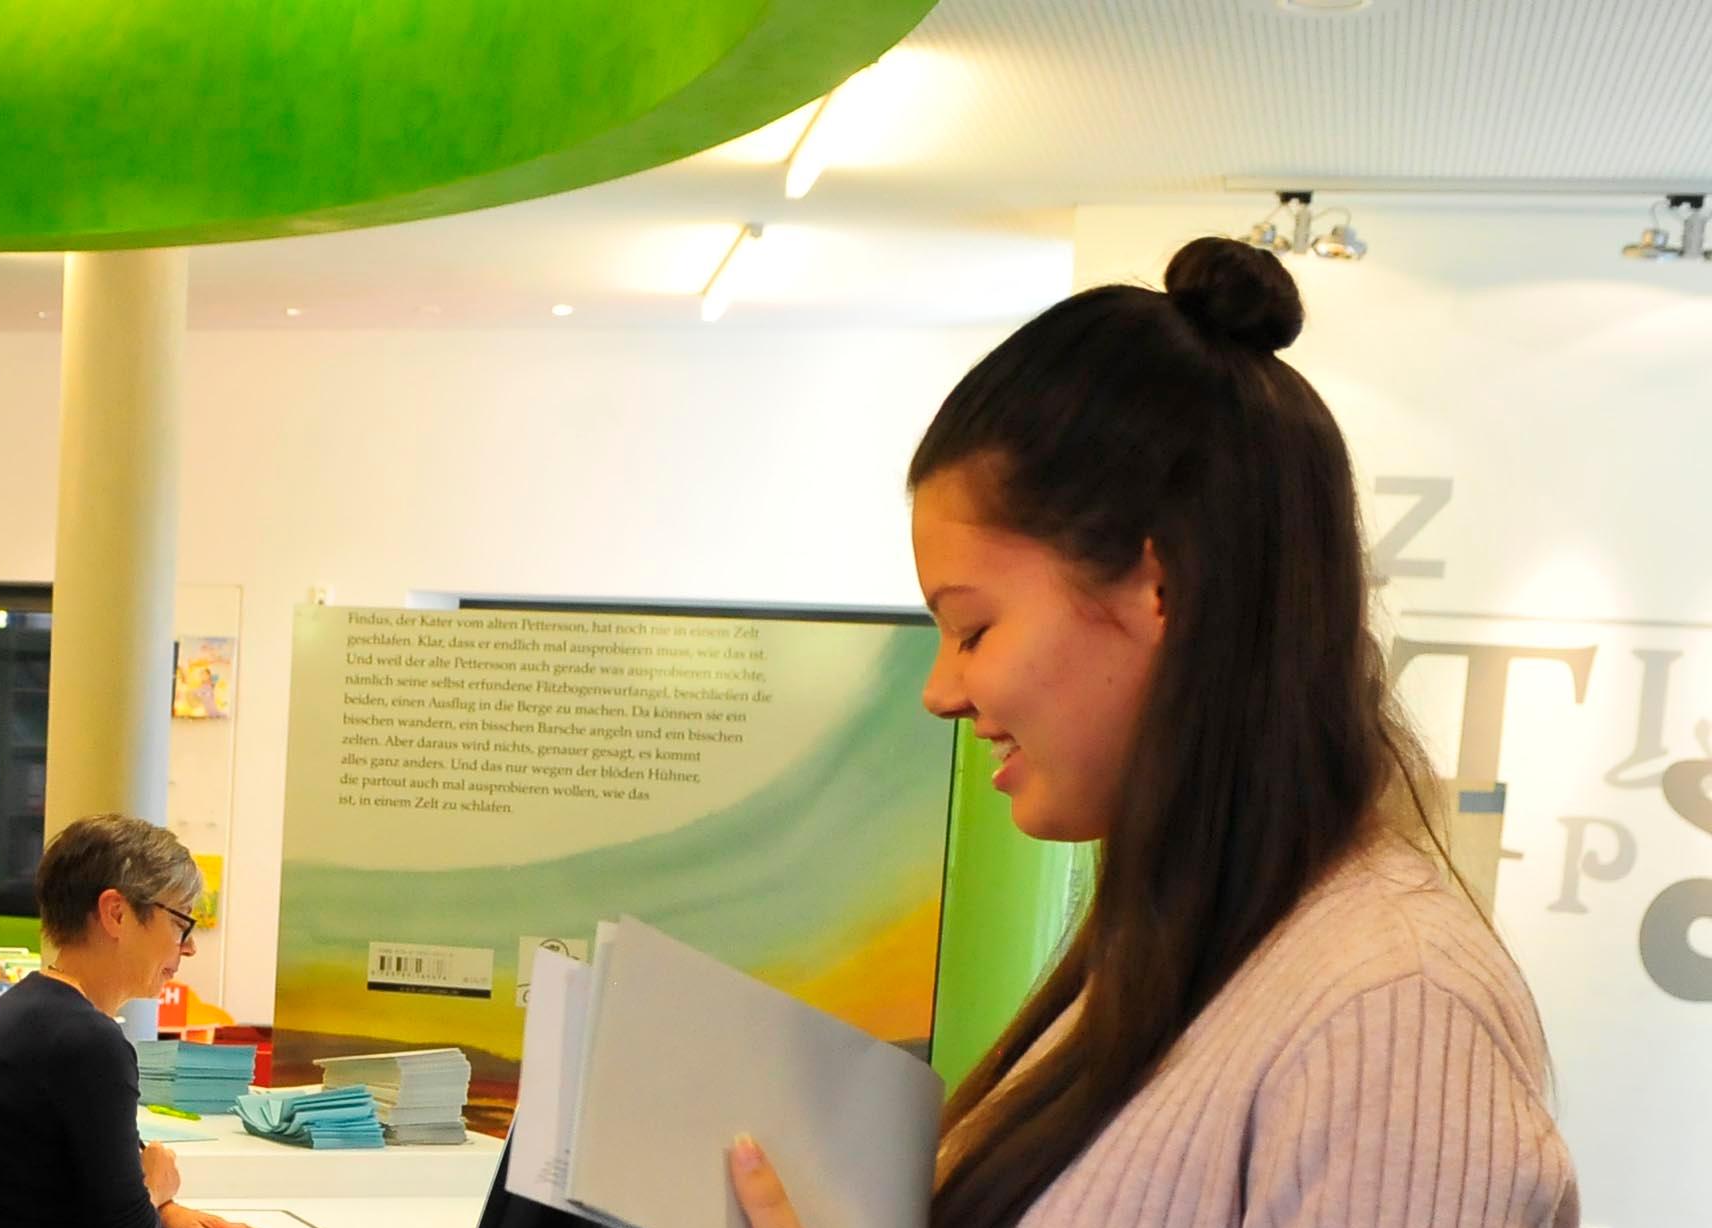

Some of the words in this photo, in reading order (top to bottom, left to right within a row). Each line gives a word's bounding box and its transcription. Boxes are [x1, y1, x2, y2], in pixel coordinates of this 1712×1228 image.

[395, 612, 418, 627] der
[419, 613, 453, 629] Kater
[456, 619, 484, 630] vom
[487, 616, 518, 631] alten
[591, 620, 613, 635] hat
[615, 621, 648, 636] noch
[733, 625, 760, 640] Zelt
[447, 634, 476, 649] dass
[477, 640, 491, 650] er
[493, 636, 541, 652] endlich
[543, 638, 568, 653] mal
[569, 639, 654, 661] ausprobieren
[697, 646, 720, 659] wie
[723, 645, 746, 660] das
[346, 651, 374, 666] Und
[375, 652, 403, 667] weil
[405, 653, 426, 668] der
[428, 654, 451, 669] alte
[454, 655, 517, 672] Pettersson
[519, 658, 551, 673] auch
[553, 659, 597, 680] gerade
[600, 666, 625, 676] was
[627, 663, 712, 684] ausprobieren
[345, 671, 394, 687] nämlich
[396, 676, 429, 689] seine
[431, 675, 465, 690] selbst
[468, 677, 533, 693] erfundene
[673, 685, 749, 702] beschließen
[751, 688, 773, 703] die
[390, 695, 426, 709] einen
[428, 695, 476, 715] Ausflug
[478, 699, 492, 712] in
[494, 698, 514, 713] die
[517, 699, 553, 718] Berge
[555, 705, 572, 715] zu
[631, 704, 650, 718] Da
[653, 705, 703, 721] können
[705, 709, 723, 722] sie
[726, 710, 747, 723] ein
[342, 711, 394, 728] bisschen
[459, 719, 479, 732] ein
[481, 718, 535, 734] bisschen
[538, 721, 587, 737] Barsche
[589, 723, 633, 743] angeln
[635, 725, 662, 741] und
[665, 729, 685, 742] ein
[688, 728, 744, 744] bisschen
[385, 733, 414, 749] Aber
[416, 735, 459, 751] daraus
[461, 737, 491, 753] wird
[537, 745, 589, 762] genauer
[638, 750, 653, 760] es
[655, 747, 701, 763] kommt
[340, 751, 368, 766] alles
[370, 757, 400, 772] ganz
[450, 757, 478, 772] Und
[480, 758, 503, 774] das
[505, 764, 528, 775] nur
[531, 765, 573, 782] wegen
[576, 764, 598, 779] der
[601, 765, 645, 781] blöden
[339, 770, 360, 785] die
[361, 771, 407, 792] partout
[409, 774, 439, 790] auch
[442, 776, 465, 791] mal
[467, 777, 550, 800] ausprobieren
[602, 786, 626, 800] wie
[628, 786, 650, 801] das
[358, 794, 372, 807] in
[373, 795, 412, 809] einem
[414, 795, 439, 811] Zelt
[441, 801, 457, 811] zu
